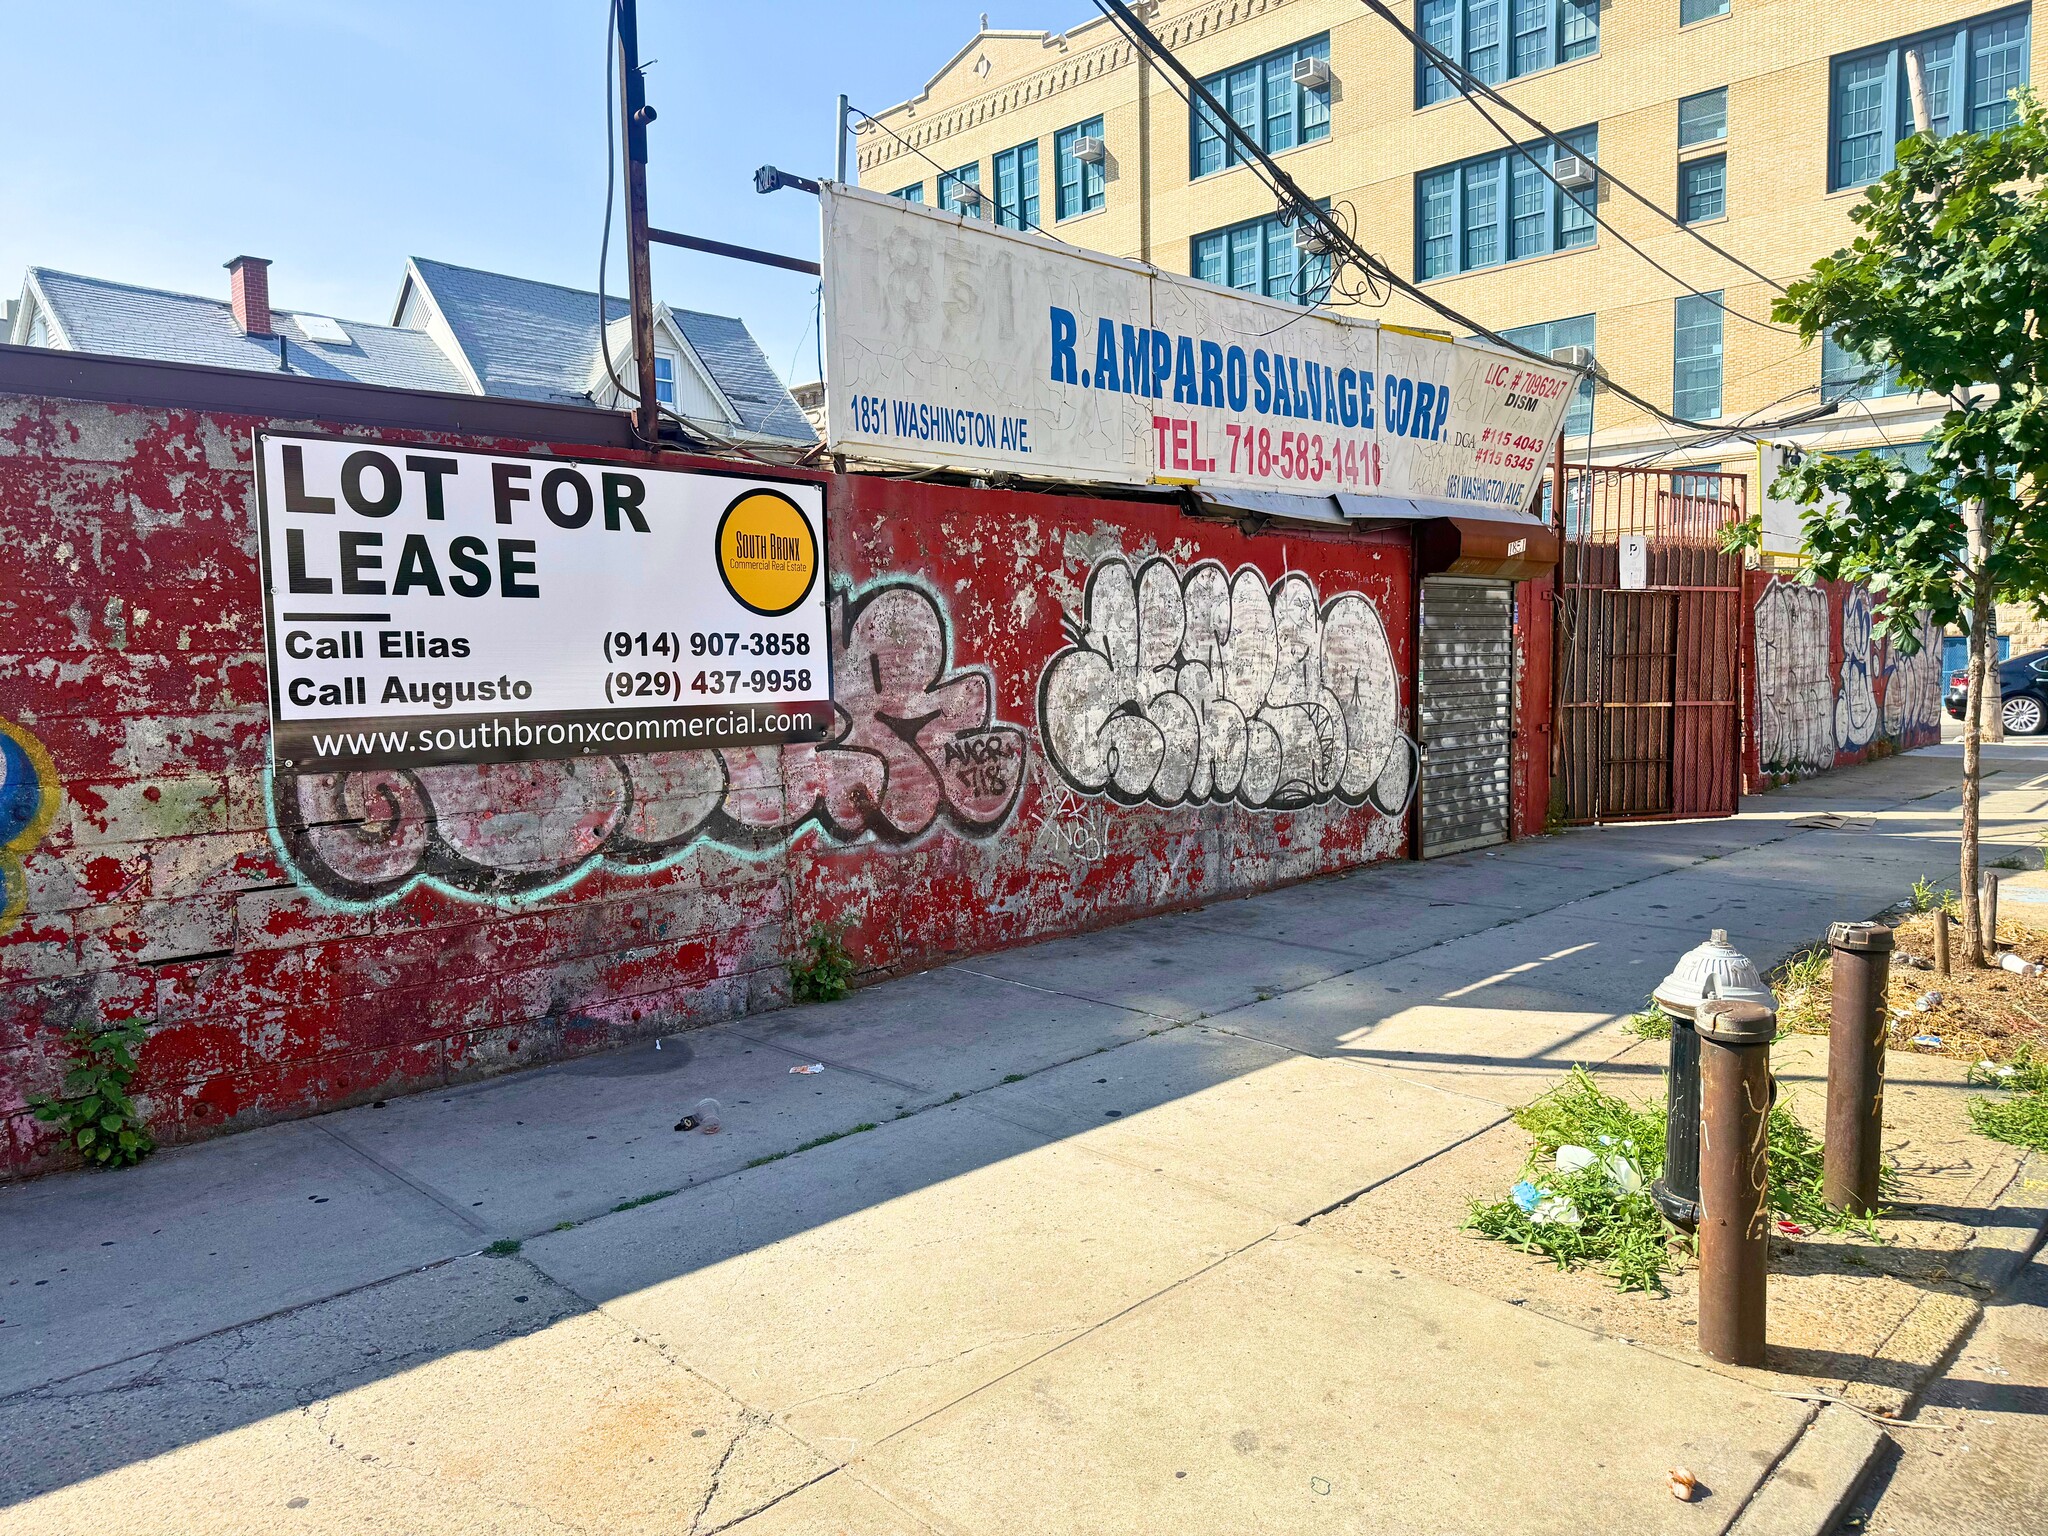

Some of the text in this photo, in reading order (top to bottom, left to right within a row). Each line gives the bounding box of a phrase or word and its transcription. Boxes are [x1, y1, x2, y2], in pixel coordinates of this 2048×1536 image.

[1254, 349, 1375, 430] SALVAGE
[1384, 374, 1449, 443] CORP.
[1484, 363, 1508, 388] LIC.
[1520, 371, 1568, 400] 7096247
[1504, 393, 1539, 412] DISM
[851, 394, 1032, 453] 1851 WASHINGTON AVE.
[1455, 432, 1475, 448] DCA
[1482, 427, 1544, 453] #115 4043
[1153, 416, 1381, 487] TEL. 718-583-1418
[1475, 448, 1535, 471] #115 6345
[281, 445, 651, 533] LOT FOR
[1446, 475, 1460, 498] 1851
[1461, 475, 1506, 503] WASHINGTON
[285, 528, 540, 599] LEASE
[730, 558, 807, 572] Commercial Real Estate
[284, 630, 811, 663] Call Elias (914) 907-3858
[288, 670, 812, 709] Call Augusto (929) 437-9958
[312, 709, 812, 758] www.southbronxcommercial.com
